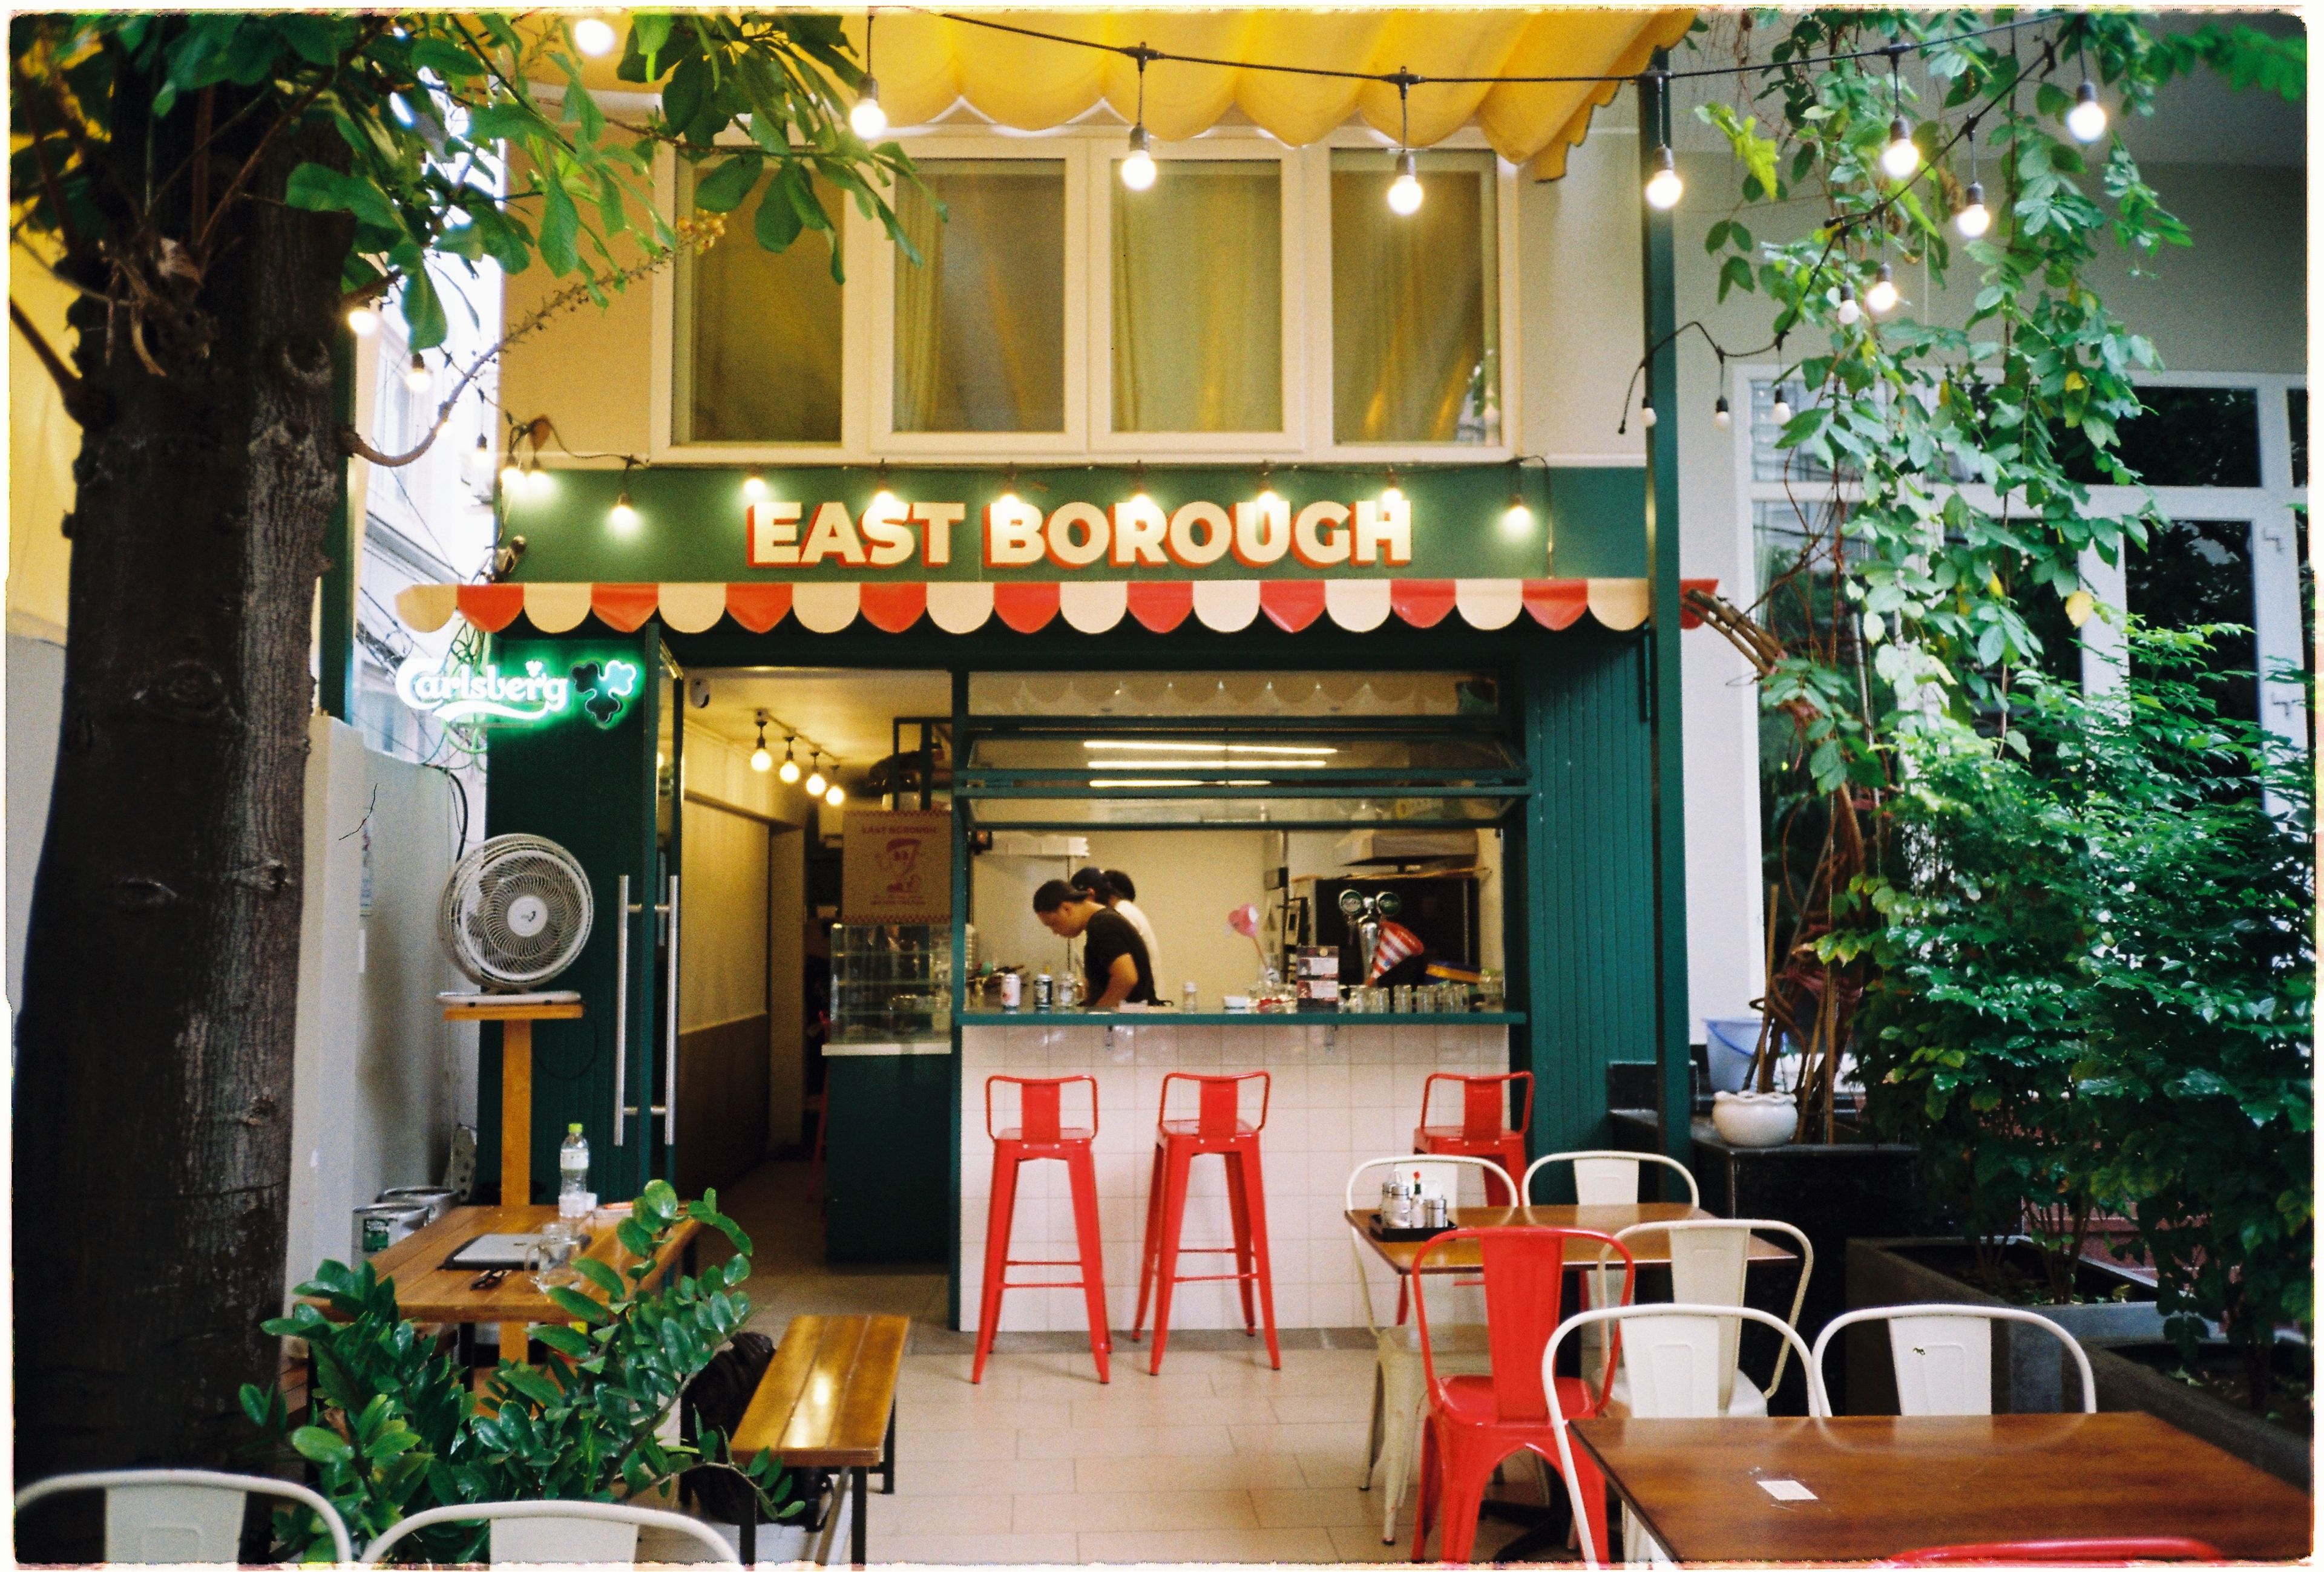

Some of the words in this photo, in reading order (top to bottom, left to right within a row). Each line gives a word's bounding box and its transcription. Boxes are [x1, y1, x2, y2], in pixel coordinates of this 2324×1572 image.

[747, 502, 965, 568] EAST
[983, 501, 1411, 568] BOROUGH
[395, 658, 568, 712] Carlsberg
